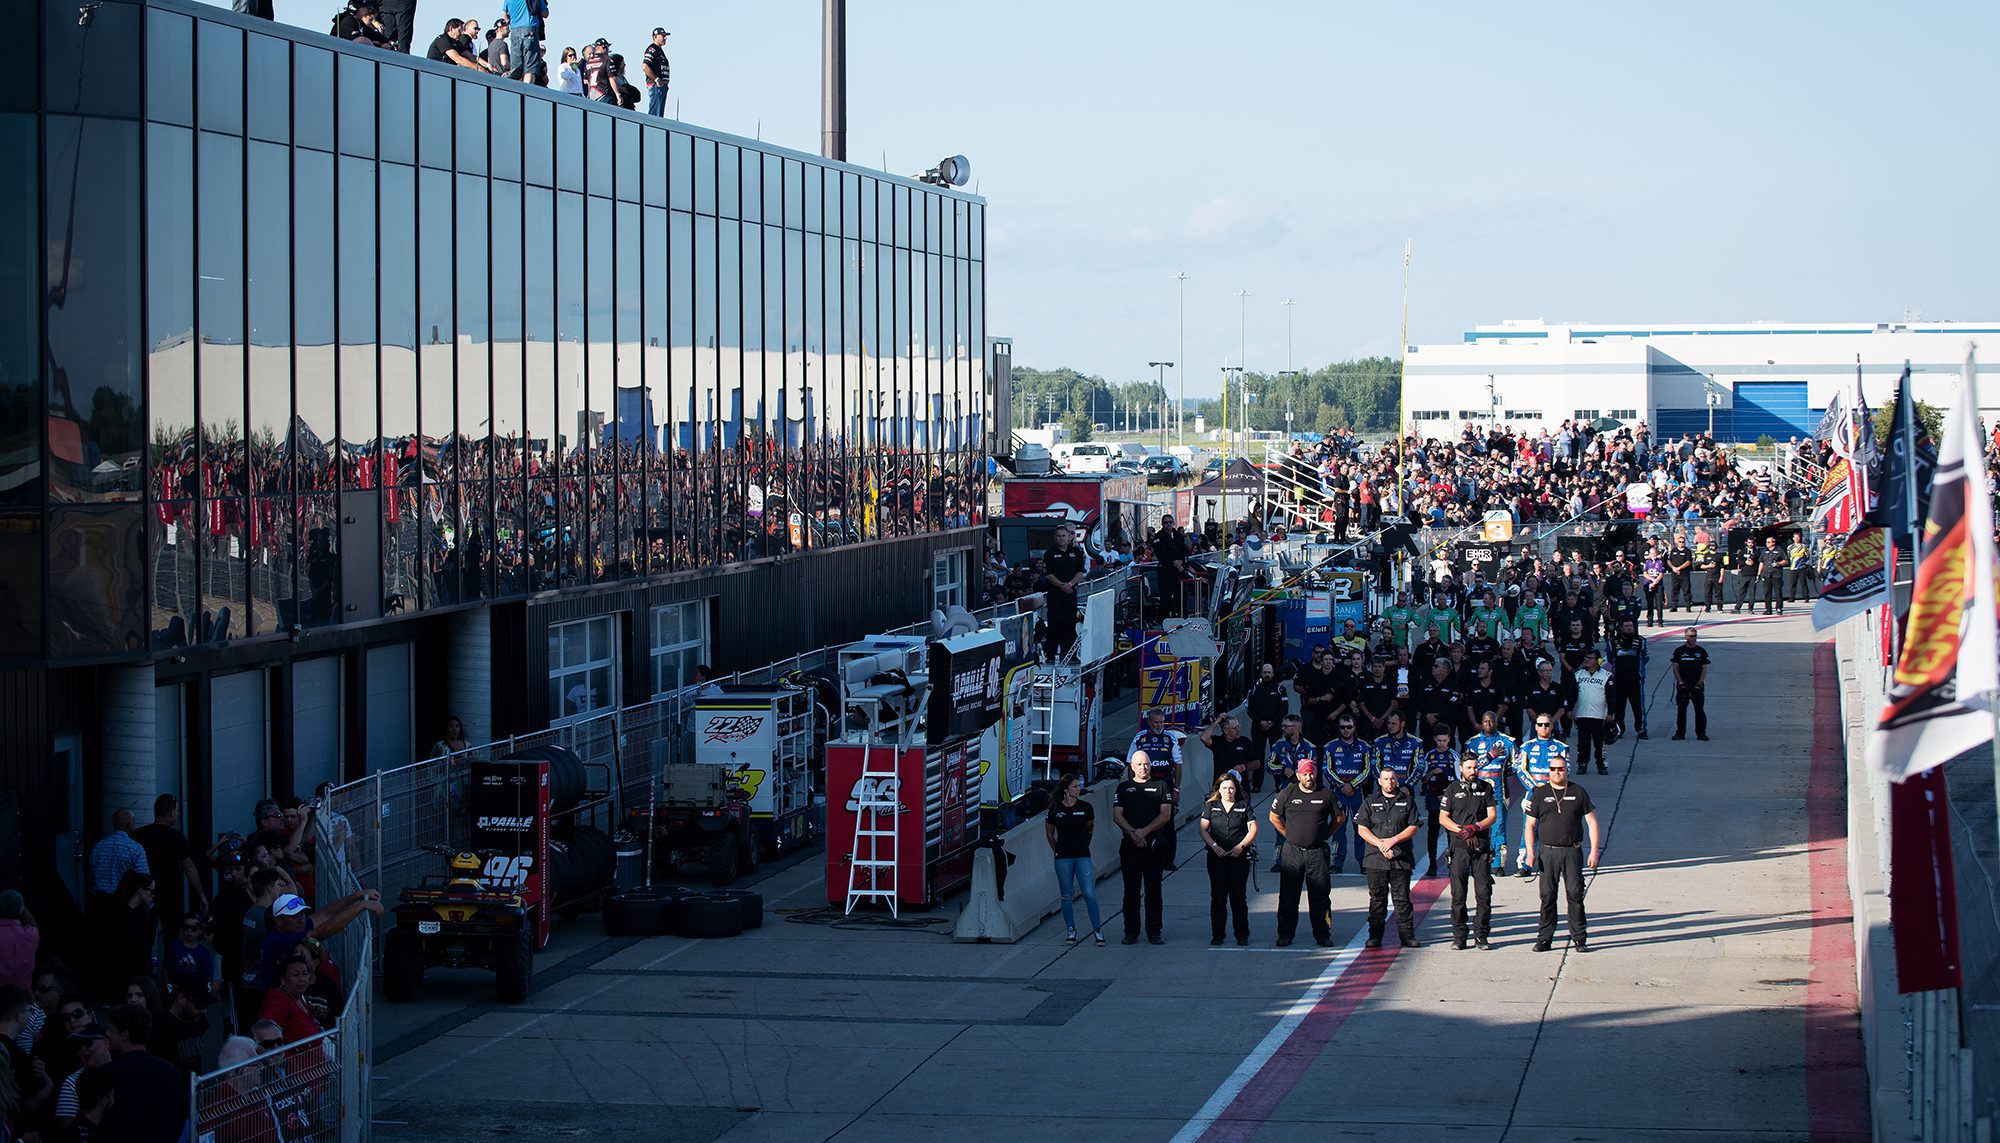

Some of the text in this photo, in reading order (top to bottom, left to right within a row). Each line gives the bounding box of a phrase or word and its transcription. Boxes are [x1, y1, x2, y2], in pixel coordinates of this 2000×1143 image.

[1149, 664, 1192, 705] 74
[1577, 676, 1604, 686] OFFICIAL
[704, 716, 740, 733] 22
